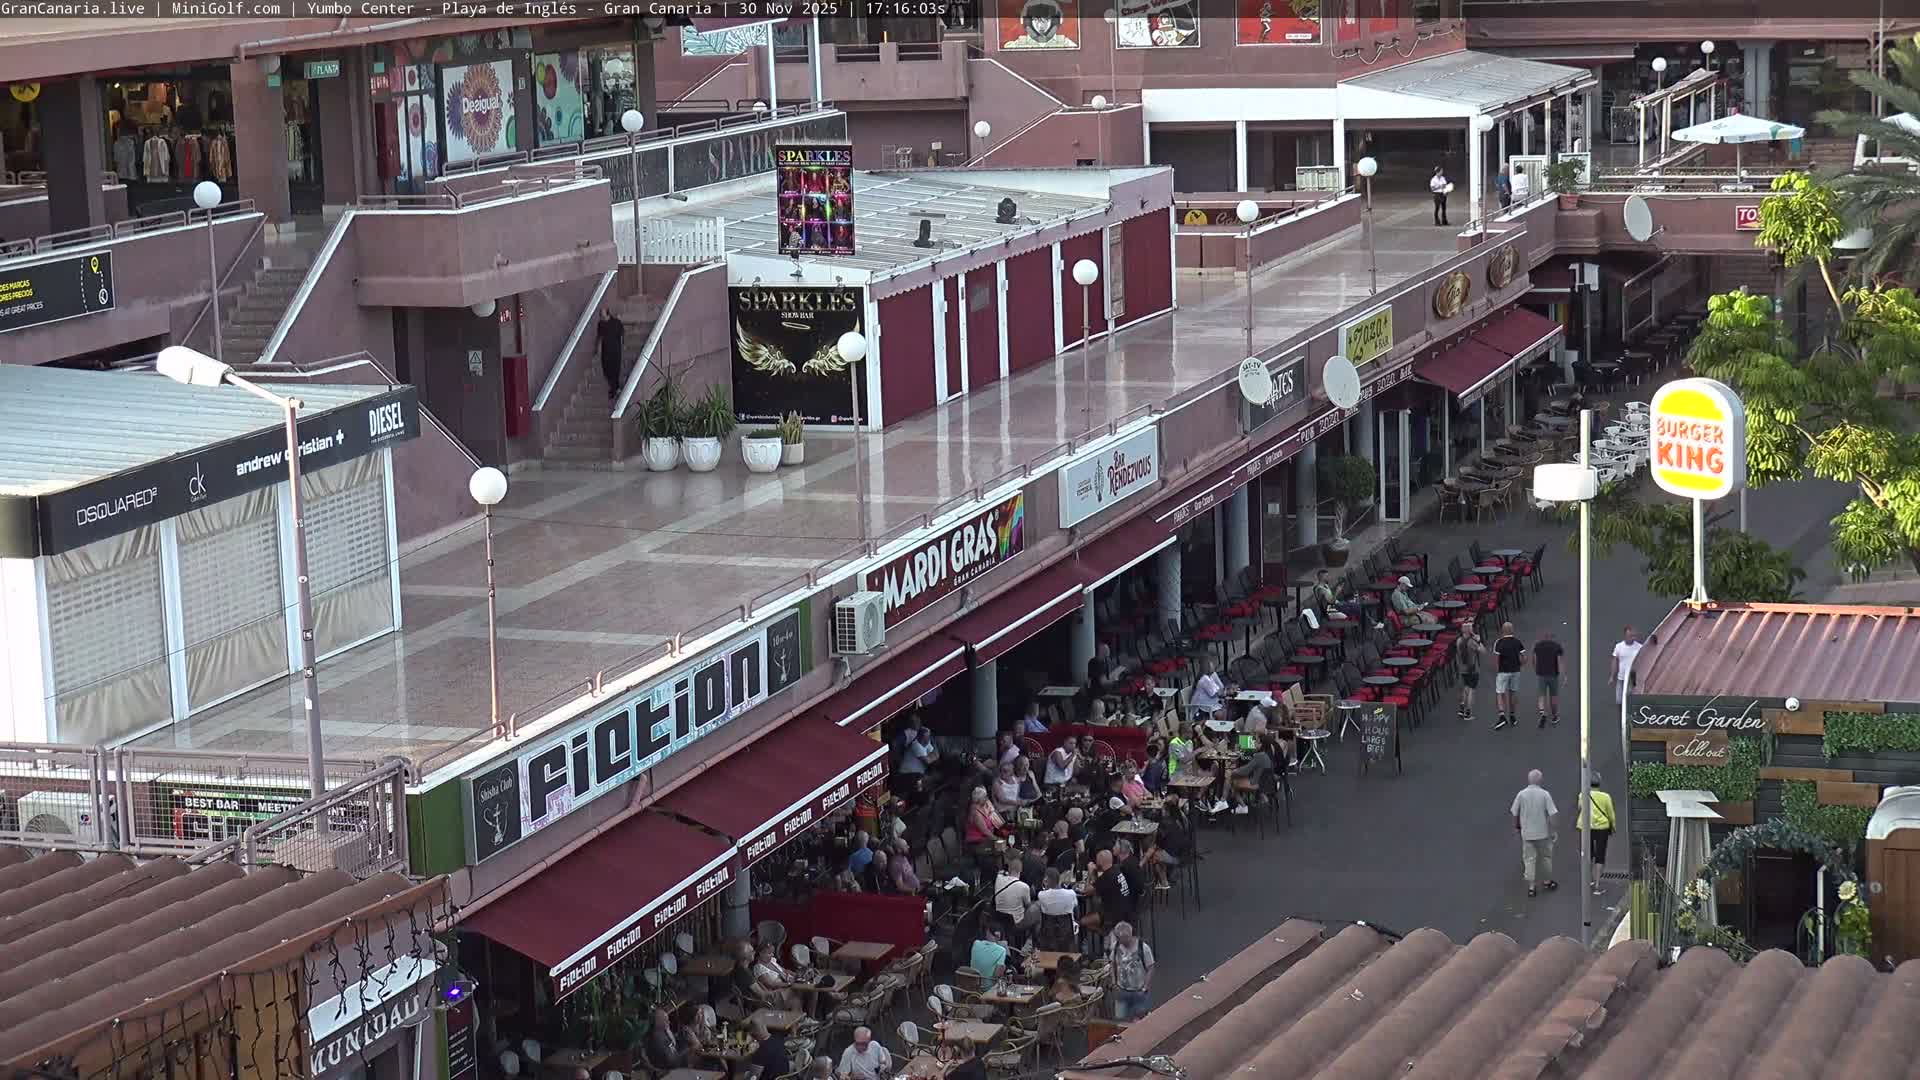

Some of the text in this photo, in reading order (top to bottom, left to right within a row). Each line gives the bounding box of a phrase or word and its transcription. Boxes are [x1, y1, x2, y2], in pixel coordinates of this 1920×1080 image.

[463, 93, 500, 114] Desigual
[779, 150, 851, 162] SPARKLES
[739, 291, 857, 312] SPARKLES
[368, 401, 404, 437] DIESEL
[1657, 416, 1724, 444] BURGER
[236, 451, 282, 476] andrew
[1657, 441, 1724, 474] KING
[189, 462, 207, 496] ck
[1107, 454, 1152, 497] RENDEZVOUS
[883, 539, 948, 613] MARDI
[954, 557, 997, 587] GRAN CANARIA
[1632, 694, 1766, 736] Secret Garden
[184, 797, 214, 809] BEST
[216, 800, 239, 811] BAR
[480, 776, 513, 803] Shisha Club
